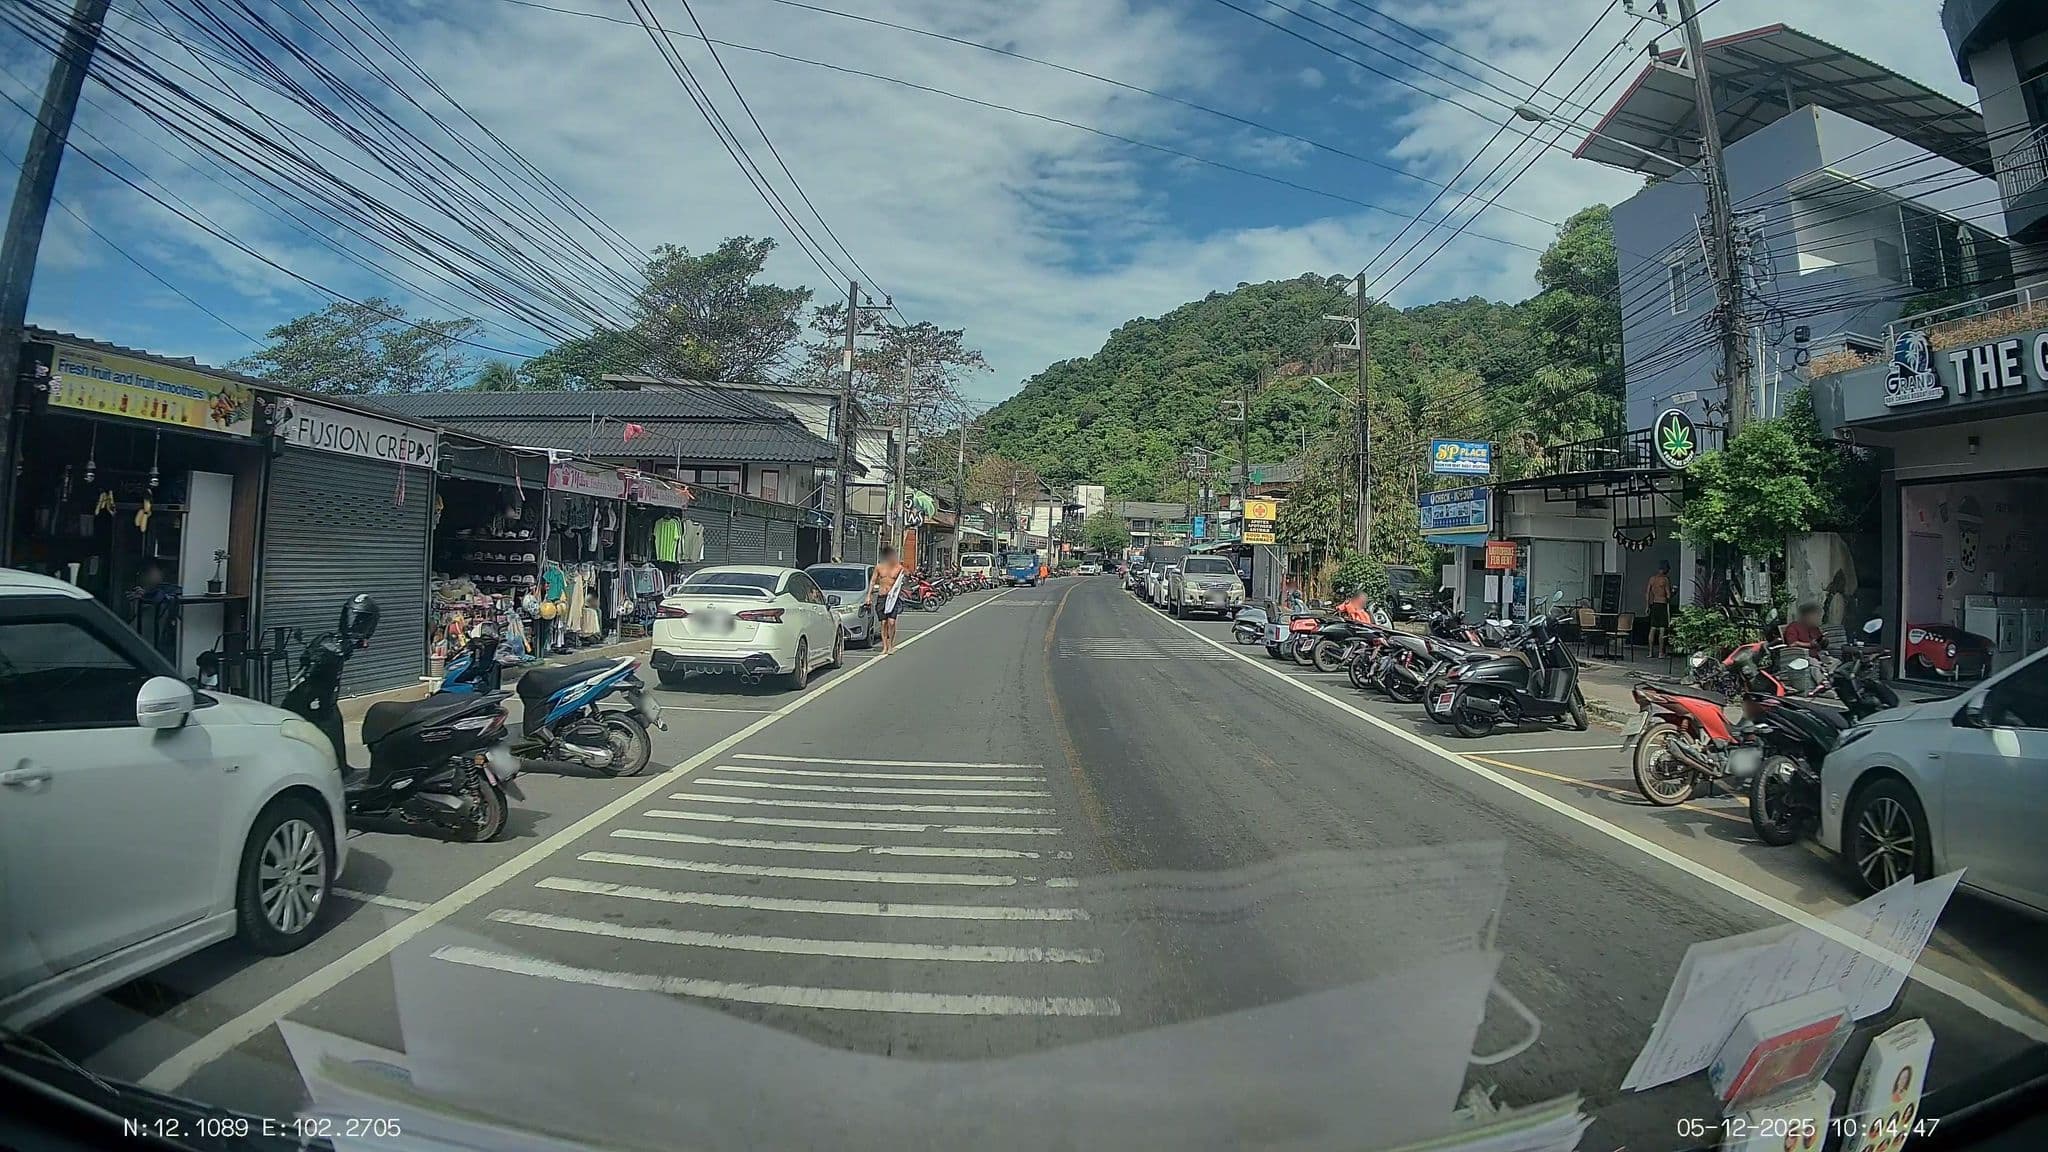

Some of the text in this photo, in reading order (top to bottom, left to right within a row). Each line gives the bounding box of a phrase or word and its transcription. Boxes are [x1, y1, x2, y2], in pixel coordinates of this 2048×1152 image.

[58, 358, 206, 399] Fresh fruit and fruit smoothies
[1949, 339, 2023, 395] THE
[1885, 371, 1936, 396] GRAND
[299, 418, 370, 454] FUSION
[1436, 444, 1487, 460] SP PLACE
[904, 494, 913, 509] 5
